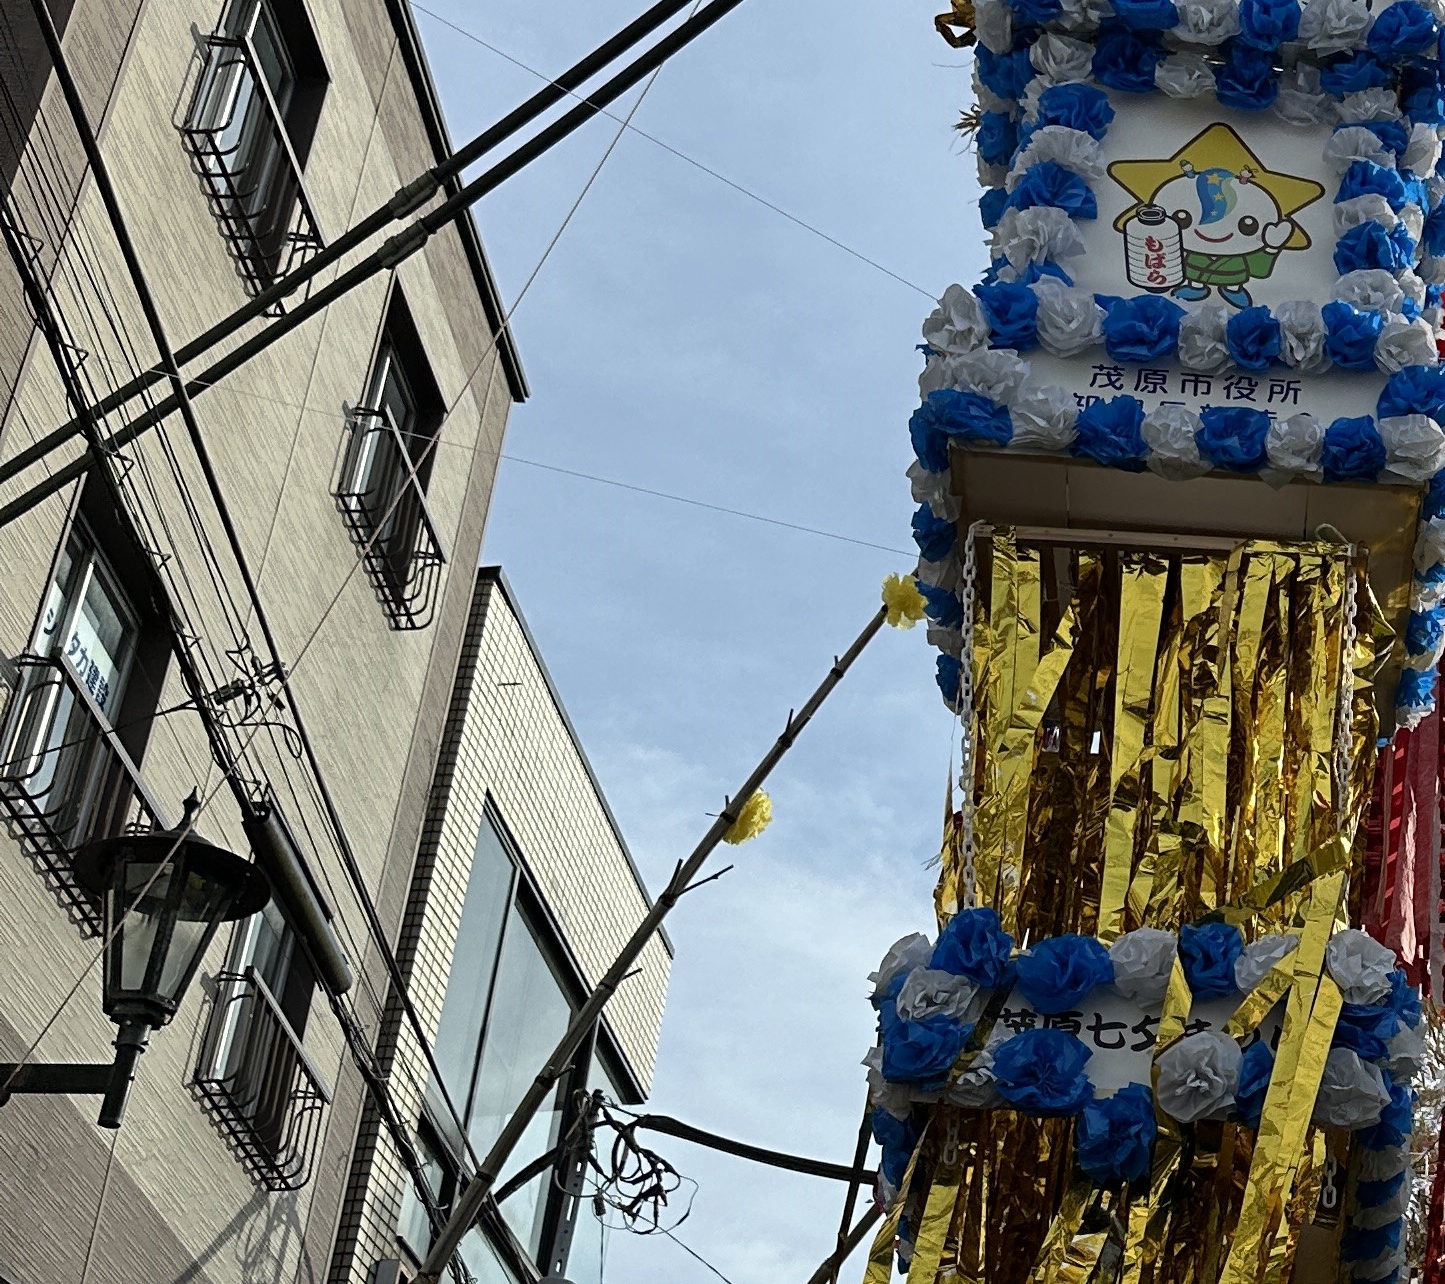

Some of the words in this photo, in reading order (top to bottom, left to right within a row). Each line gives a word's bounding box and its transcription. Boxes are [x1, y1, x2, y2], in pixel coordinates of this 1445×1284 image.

[1145, 235, 1167, 285] もばら
[1089, 364, 1302, 405] 茂原市役所
